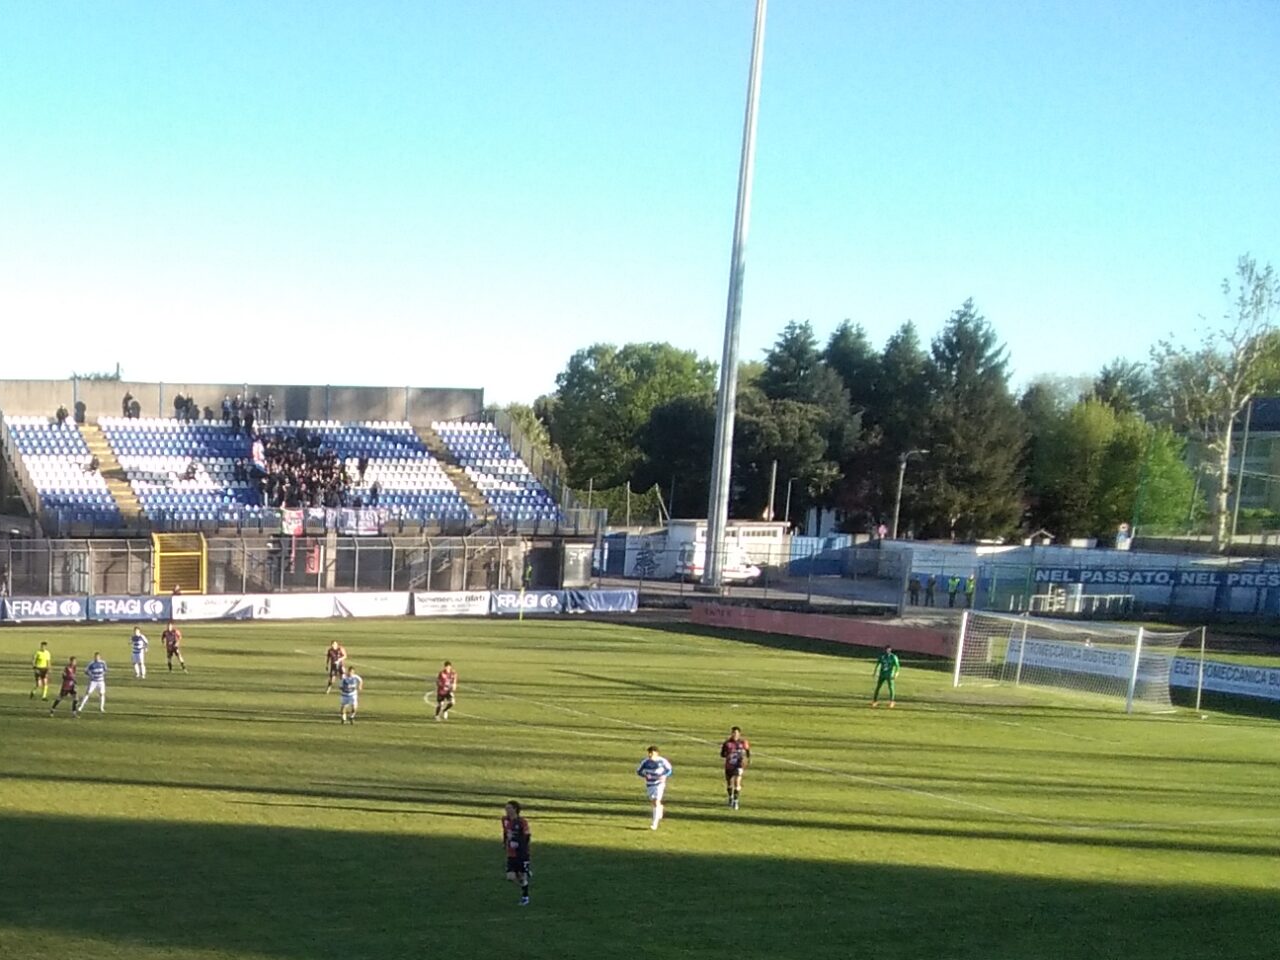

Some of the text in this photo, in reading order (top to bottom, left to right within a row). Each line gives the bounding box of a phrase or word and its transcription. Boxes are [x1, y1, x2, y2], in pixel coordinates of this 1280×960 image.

[1035, 570, 1073, 582] NEL
[1079, 570, 1174, 584] PASSATO,
[1181, 573, 1220, 585] NEL
[11, 600, 57, 616] FRAGI
[95, 599, 140, 615] FRAGI
